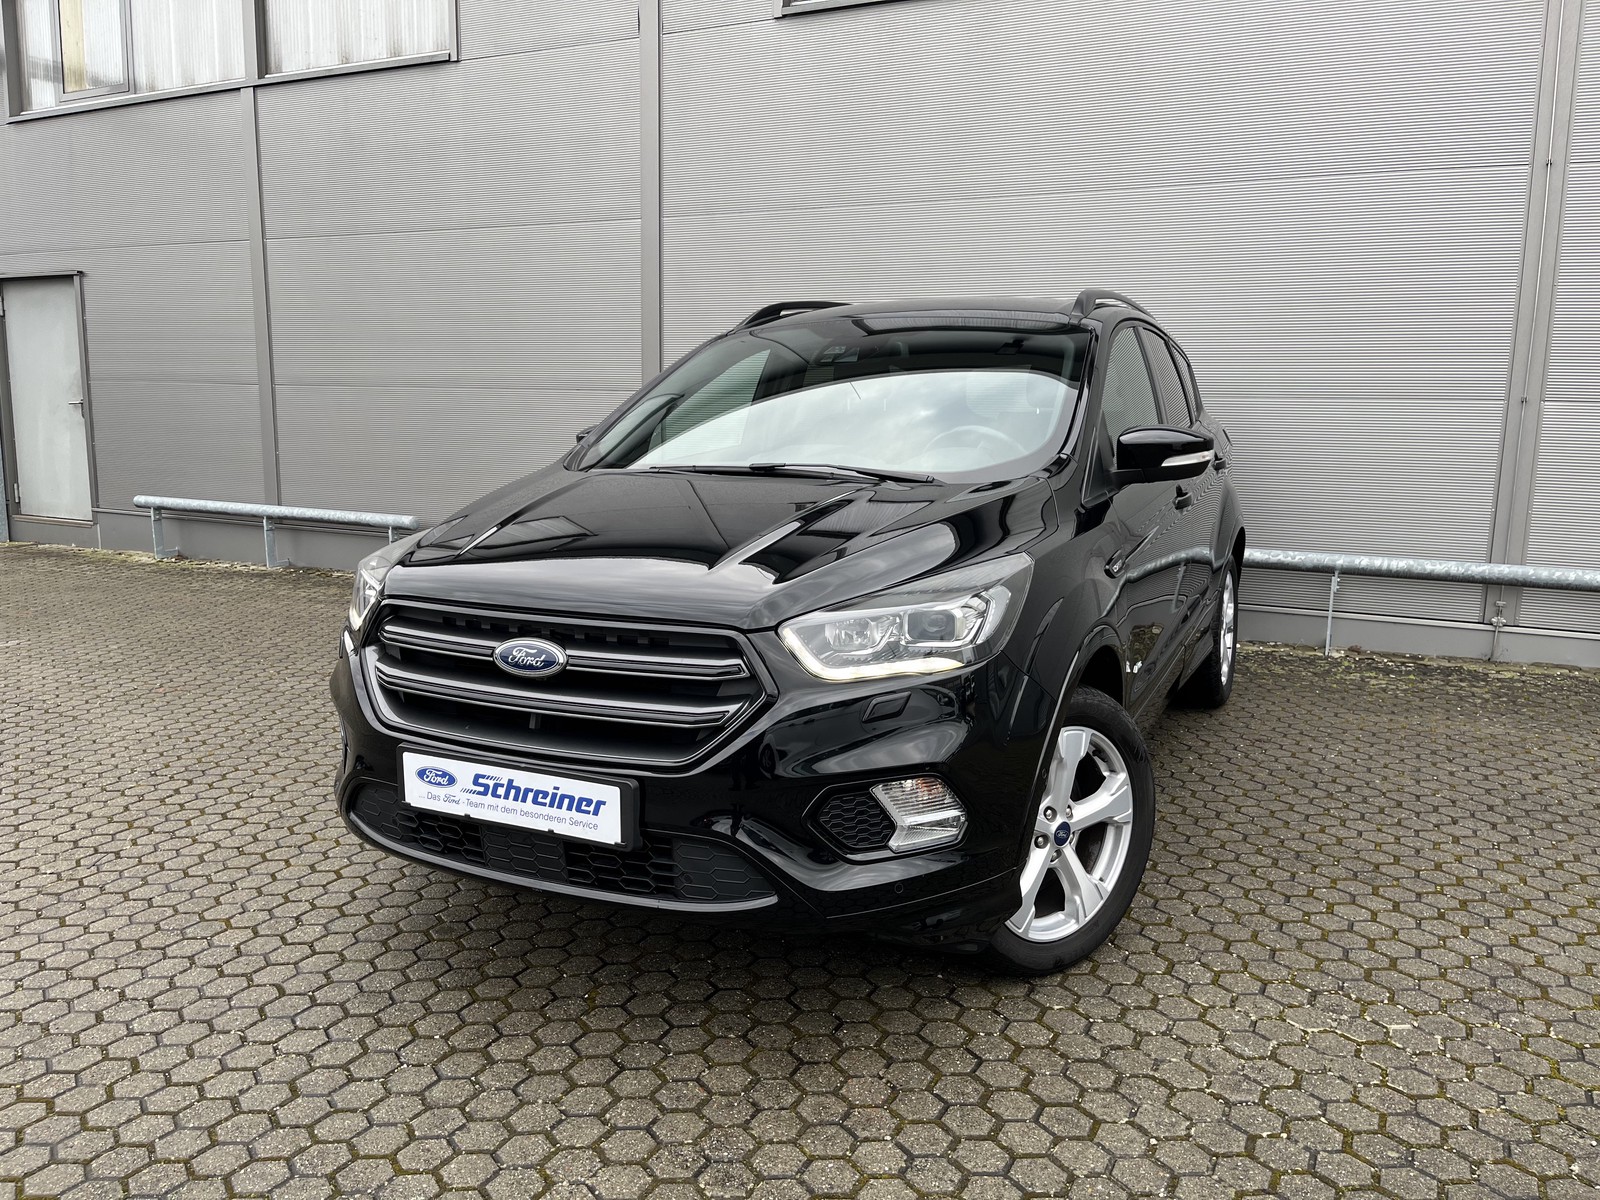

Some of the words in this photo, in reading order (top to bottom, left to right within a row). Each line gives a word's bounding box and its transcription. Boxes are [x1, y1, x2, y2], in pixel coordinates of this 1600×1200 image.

[508, 646, 546, 667] Ford
[423, 768, 449, 785] Ford
[471, 772, 607, 816] Schreiner
[426, 791, 441, 802] Das
[443, 793, 461, 805] Ford
[487, 804, 499, 812] mit
[500, 804, 518, 815] dem
[519, 808, 567, 824] besonderen
[568, 816, 599, 830] Service
